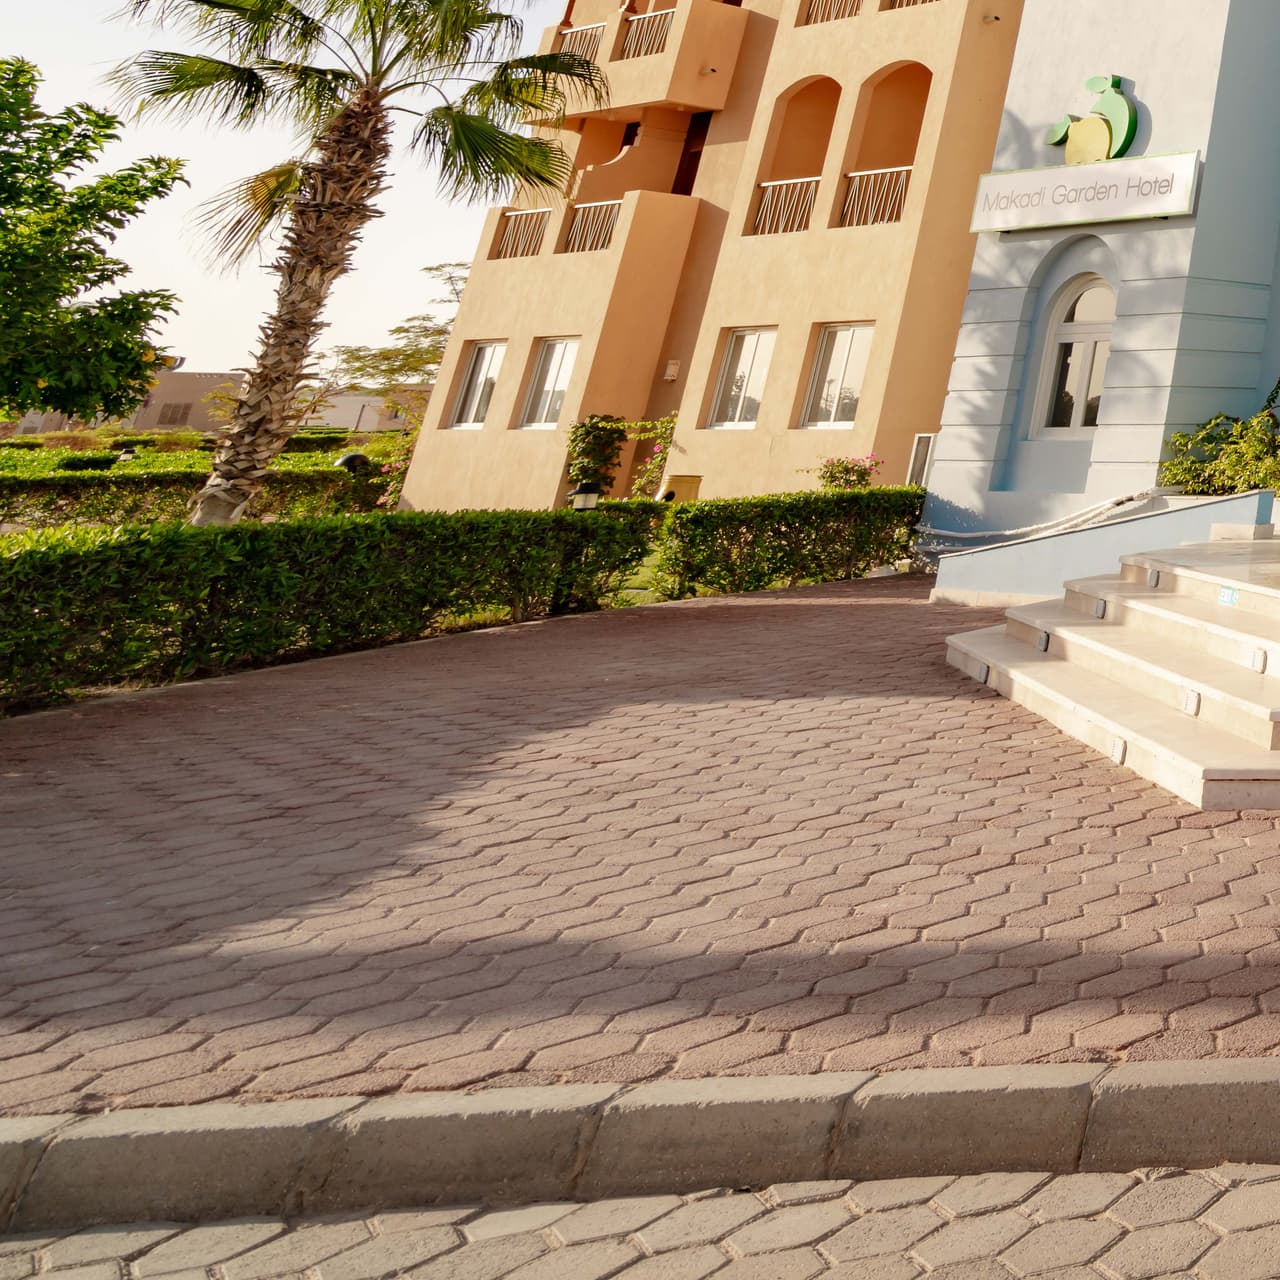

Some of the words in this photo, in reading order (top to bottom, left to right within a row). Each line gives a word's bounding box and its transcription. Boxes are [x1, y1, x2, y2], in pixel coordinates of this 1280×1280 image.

[983, 186, 1046, 212] Makadi
[1052, 181, 1119, 205] Garden
[1125, 172, 1175, 198] Hotel
